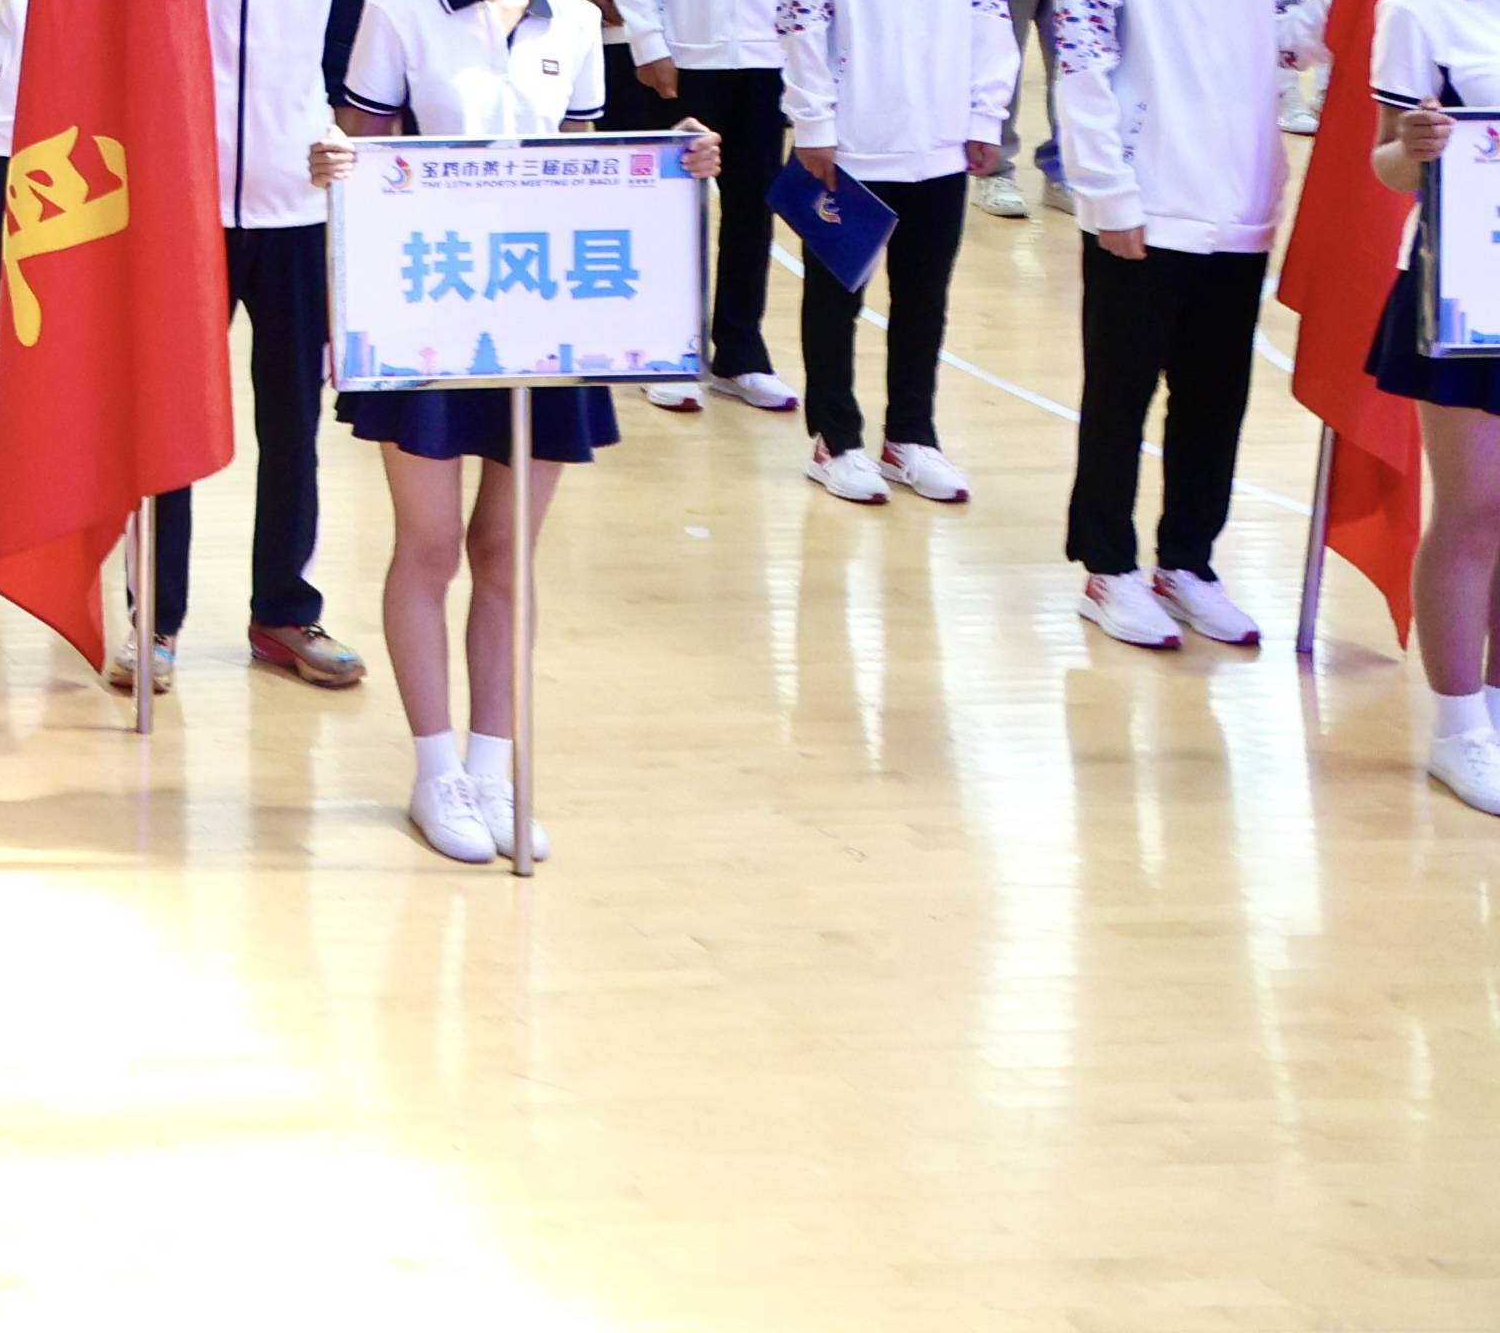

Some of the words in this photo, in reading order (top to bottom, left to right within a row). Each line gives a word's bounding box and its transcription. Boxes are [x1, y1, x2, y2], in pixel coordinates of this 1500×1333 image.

[421, 158, 620, 179] 宝鸡市第十三届运动会
[400, 229, 639, 303] 扶风县
